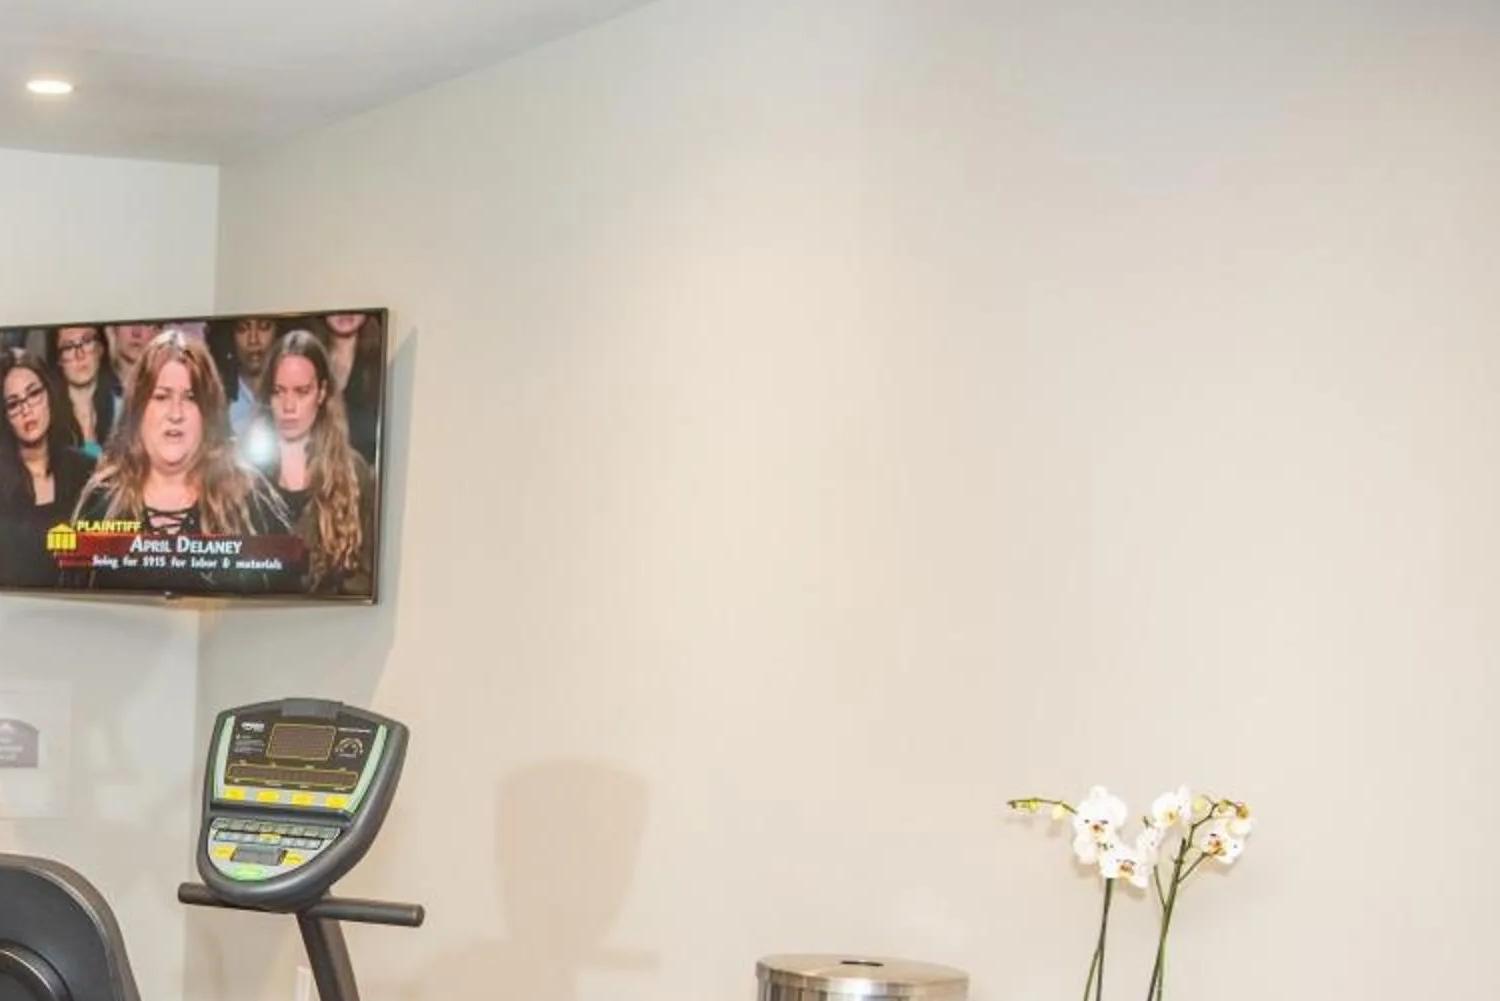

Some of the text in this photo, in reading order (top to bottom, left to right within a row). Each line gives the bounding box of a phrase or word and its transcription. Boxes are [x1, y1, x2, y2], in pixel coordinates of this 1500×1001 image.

[77, 520, 141, 533] PLAINTIFF
[122, 555, 138, 567] for
[191, 556, 217, 569] labor
[235, 557, 282, 570] materials
